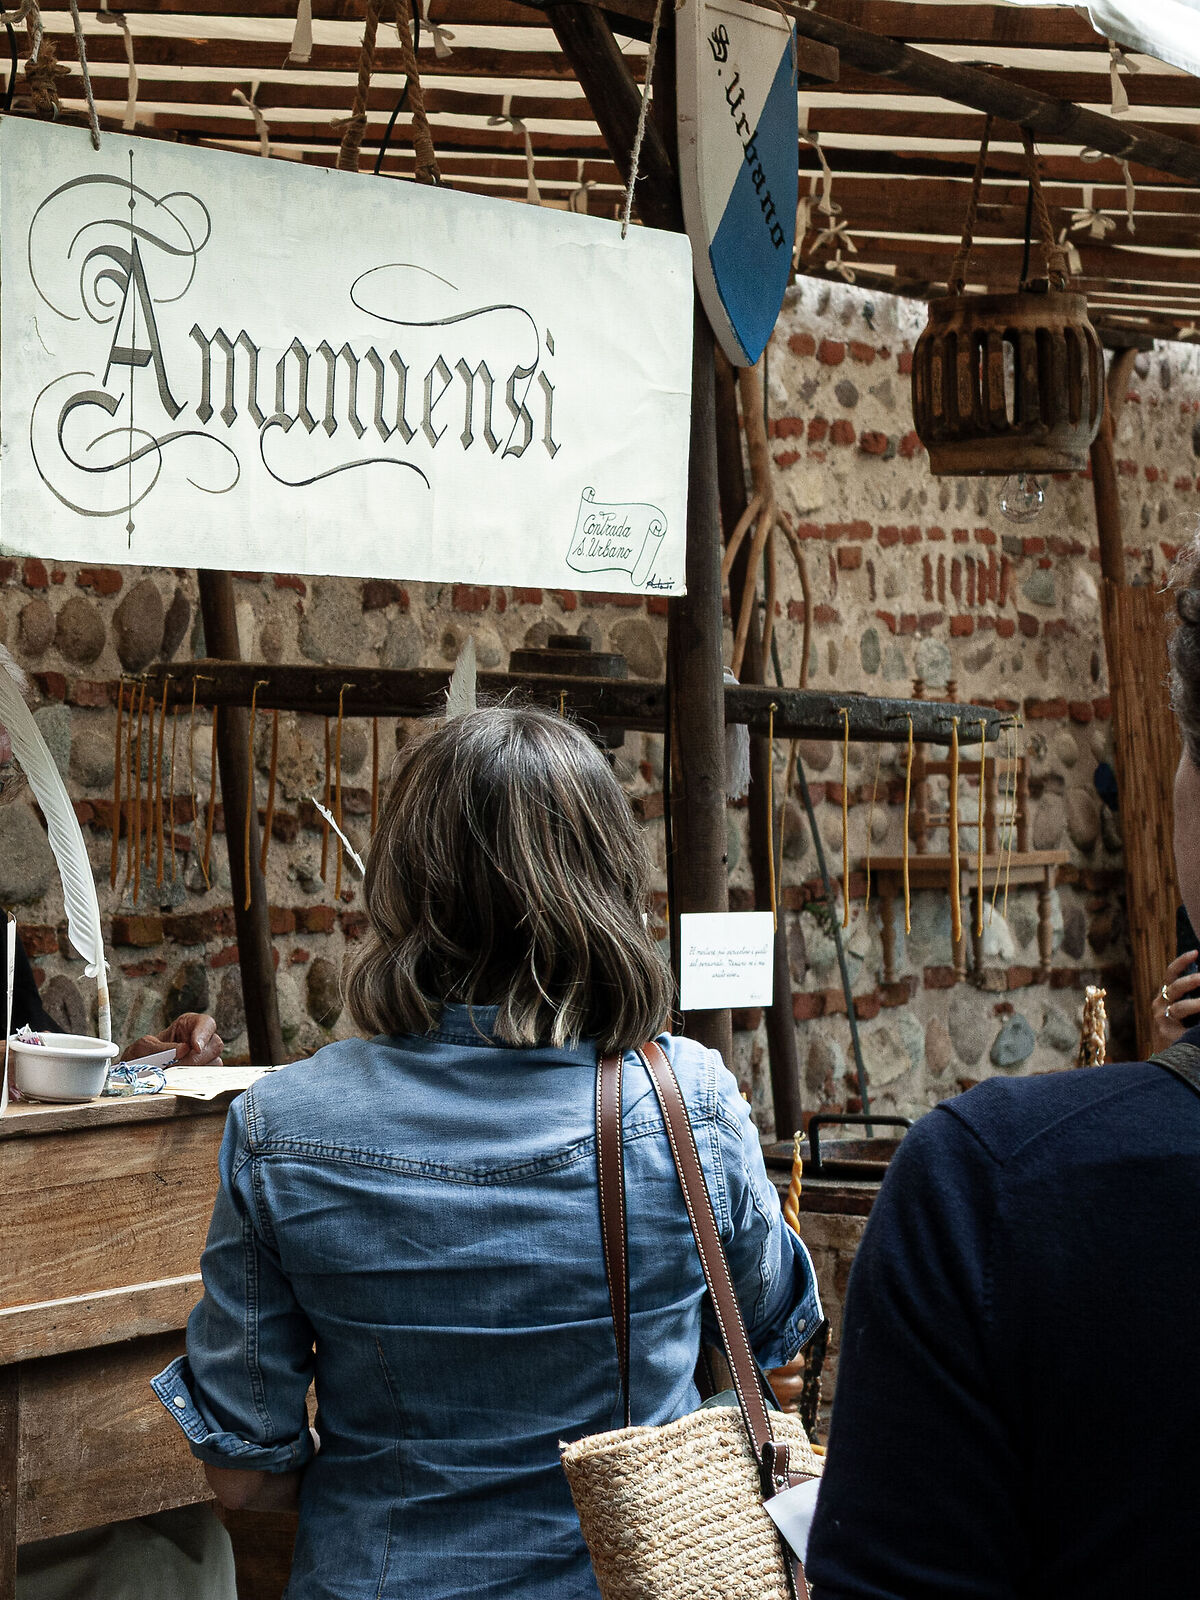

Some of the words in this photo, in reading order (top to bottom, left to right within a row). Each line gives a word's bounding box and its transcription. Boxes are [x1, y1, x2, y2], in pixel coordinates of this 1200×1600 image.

[707, 23, 730, 77] S.
[725, 71, 785, 250] Urbano
[45, 205, 563, 490] Amanuensi
[583, 511, 631, 538] Contrada
[586, 537, 633, 560] Urbano
